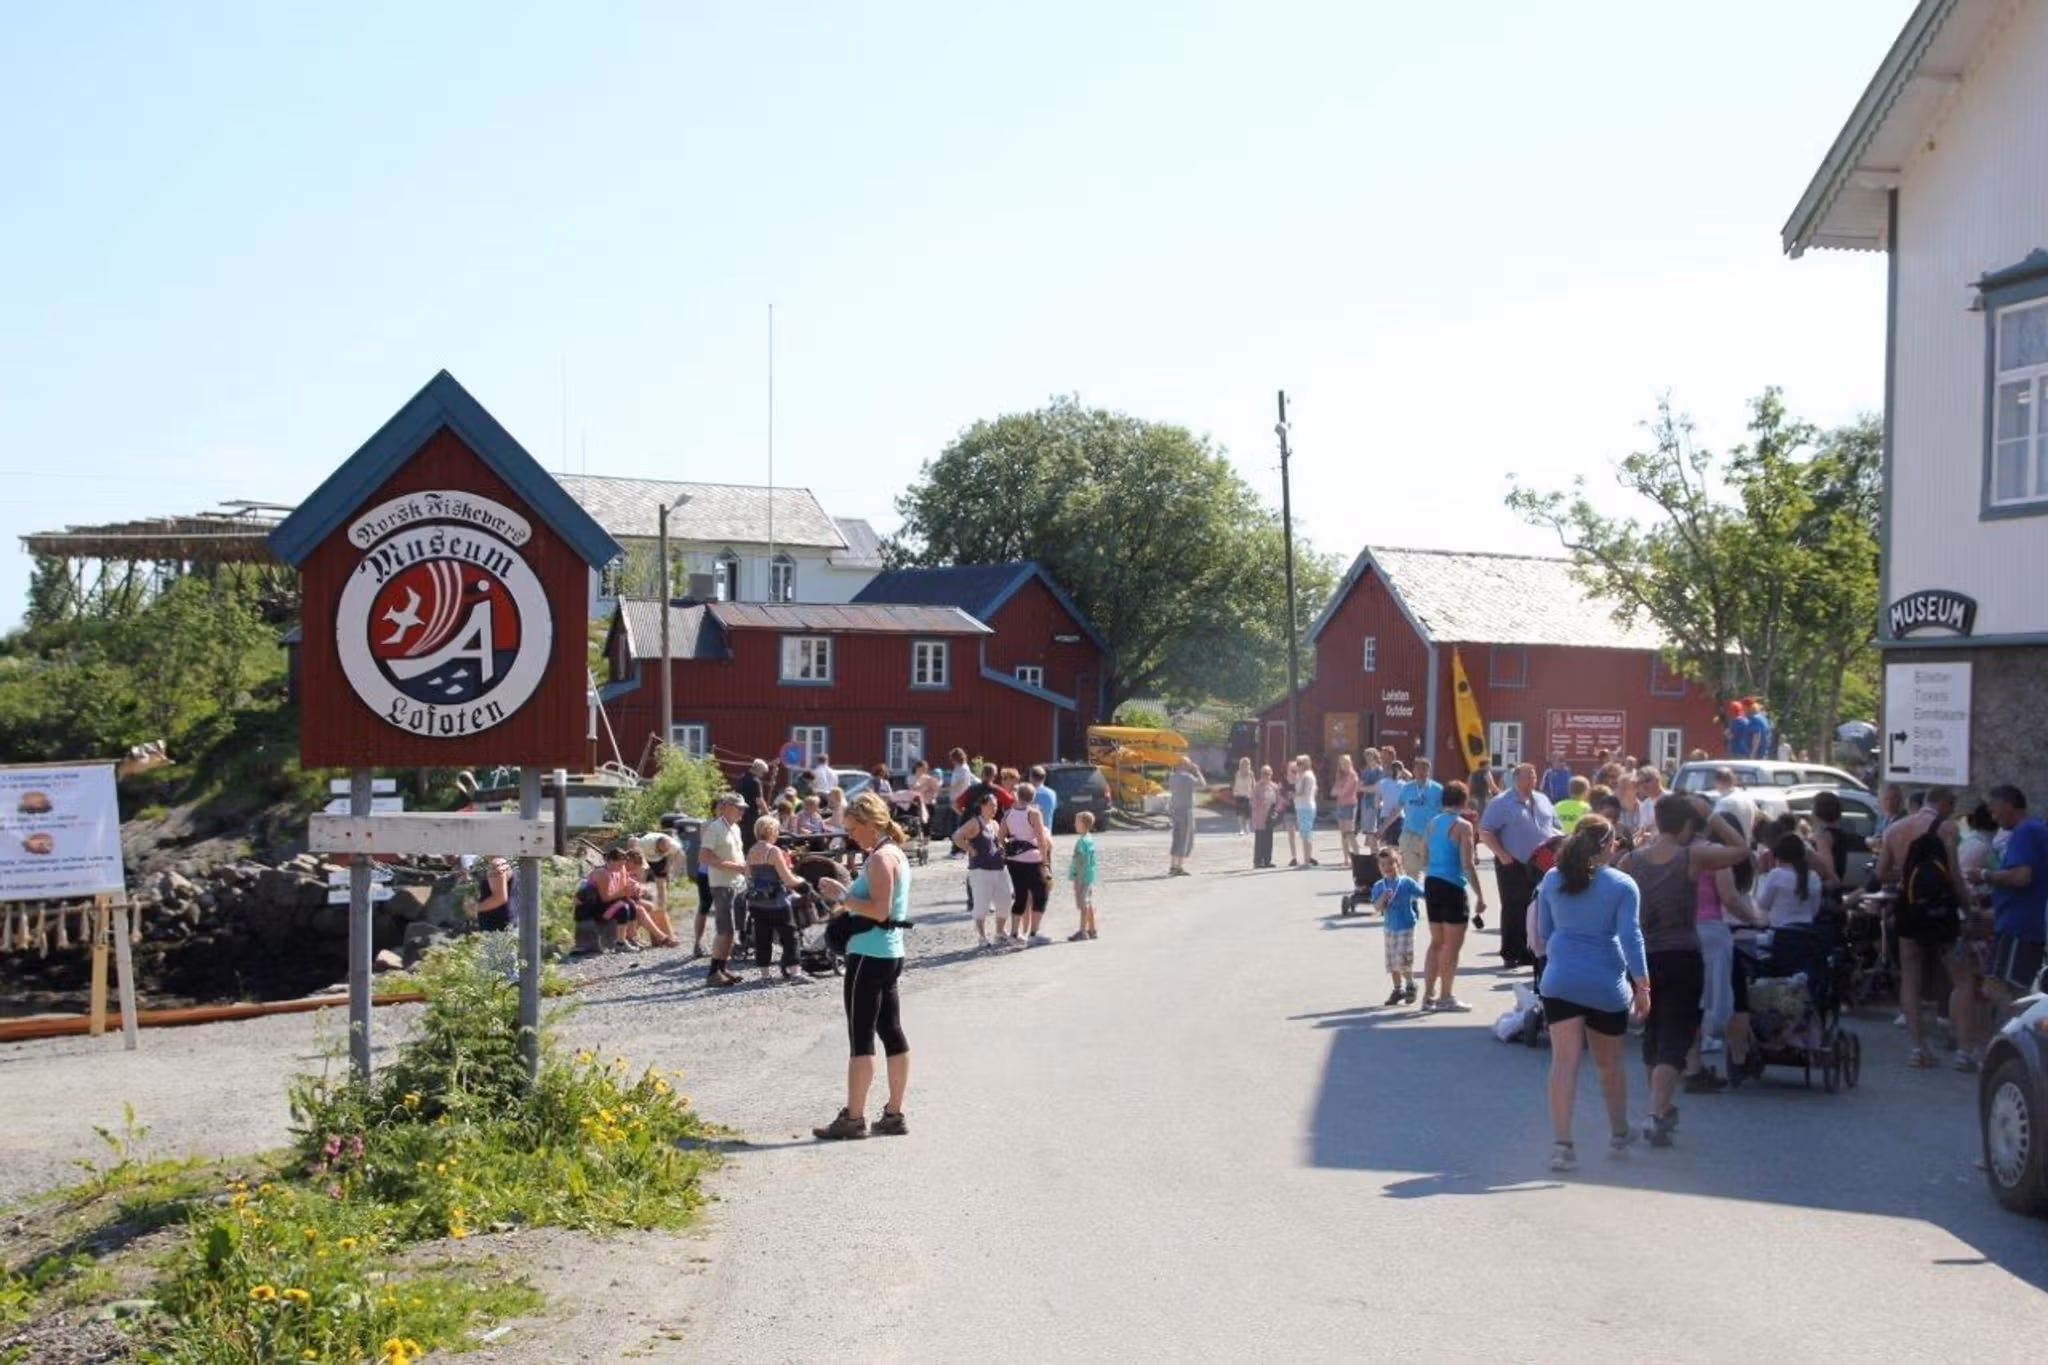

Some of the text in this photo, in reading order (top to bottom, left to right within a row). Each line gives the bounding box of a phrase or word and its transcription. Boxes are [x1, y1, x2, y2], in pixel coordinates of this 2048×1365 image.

[356, 499, 423, 544] Norsk
[359, 526, 514, 584] Museum
[1891, 596, 1966, 631] MUSEUM
[385, 696, 505, 735] Lofoten
[1385, 704, 1414, 717] Outdoor
